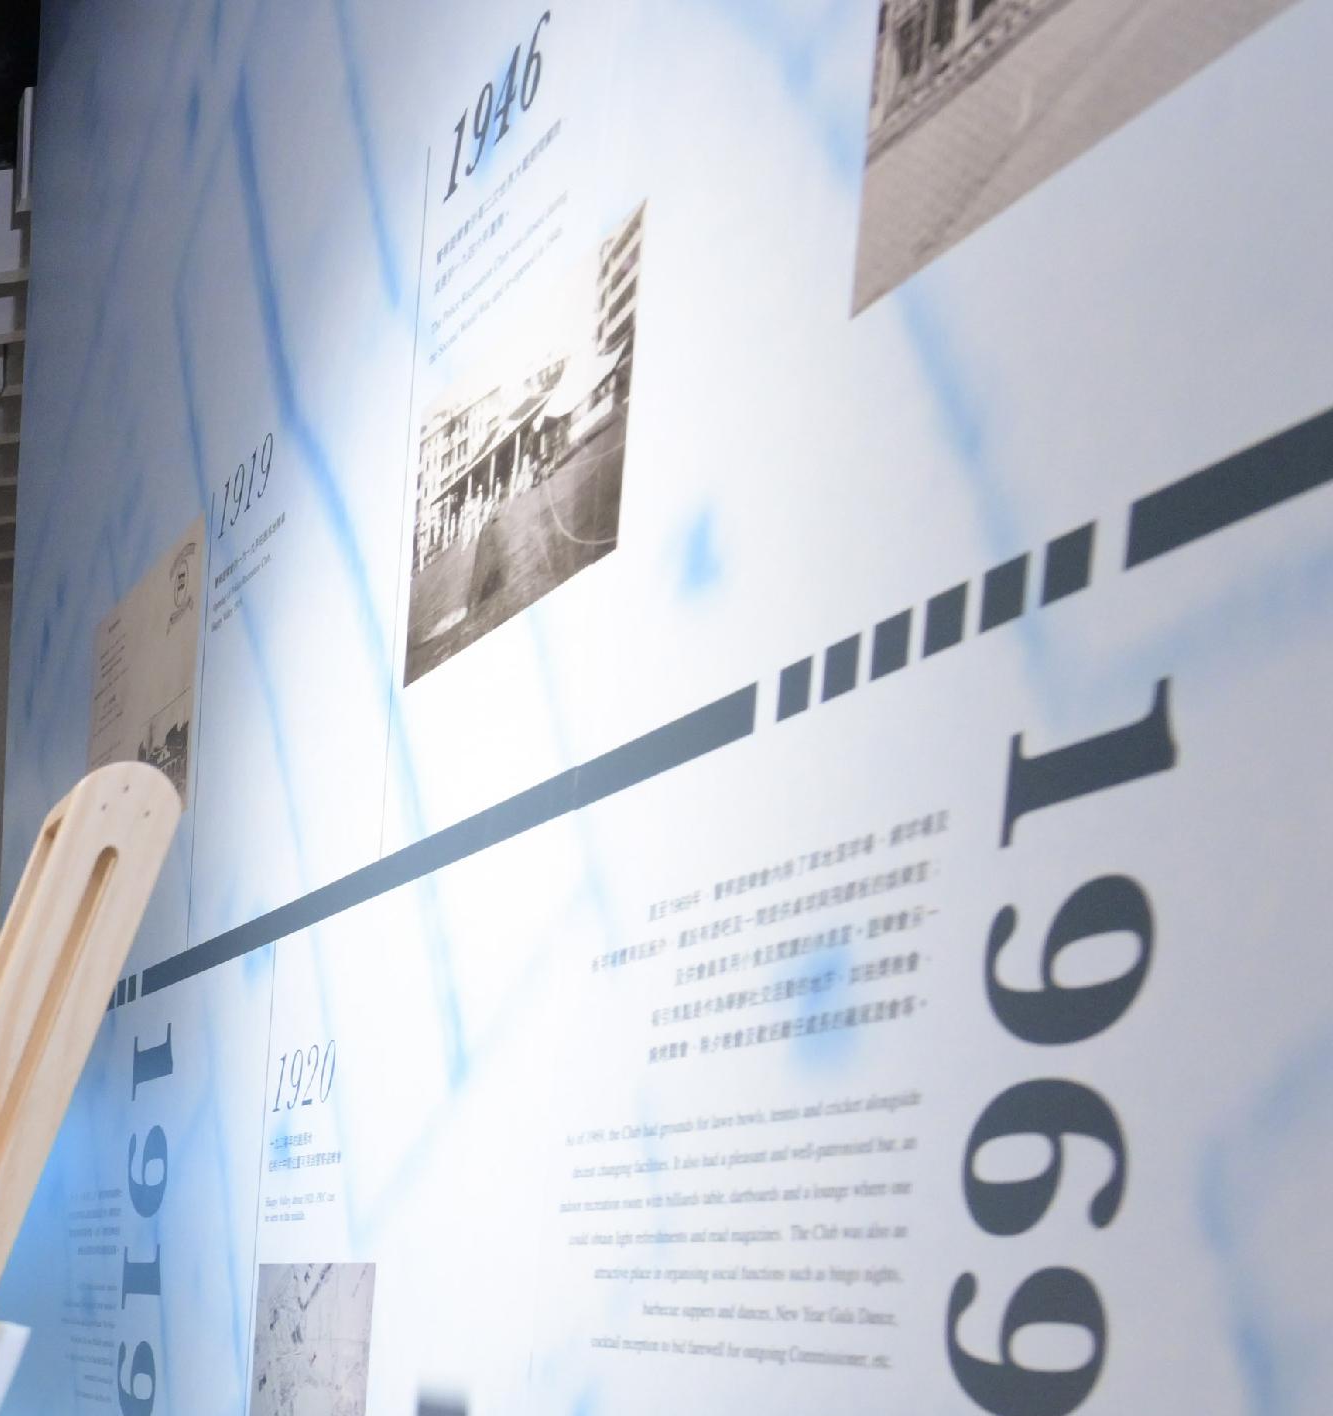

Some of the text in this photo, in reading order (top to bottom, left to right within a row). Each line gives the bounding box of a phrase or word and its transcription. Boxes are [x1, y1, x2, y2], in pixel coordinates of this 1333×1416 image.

[442, 9, 552, 204] 1946
[218, 432, 274, 539] 1919
[272, 1039, 336, 1113] 1920
[790, 1225, 808, 1241] The
